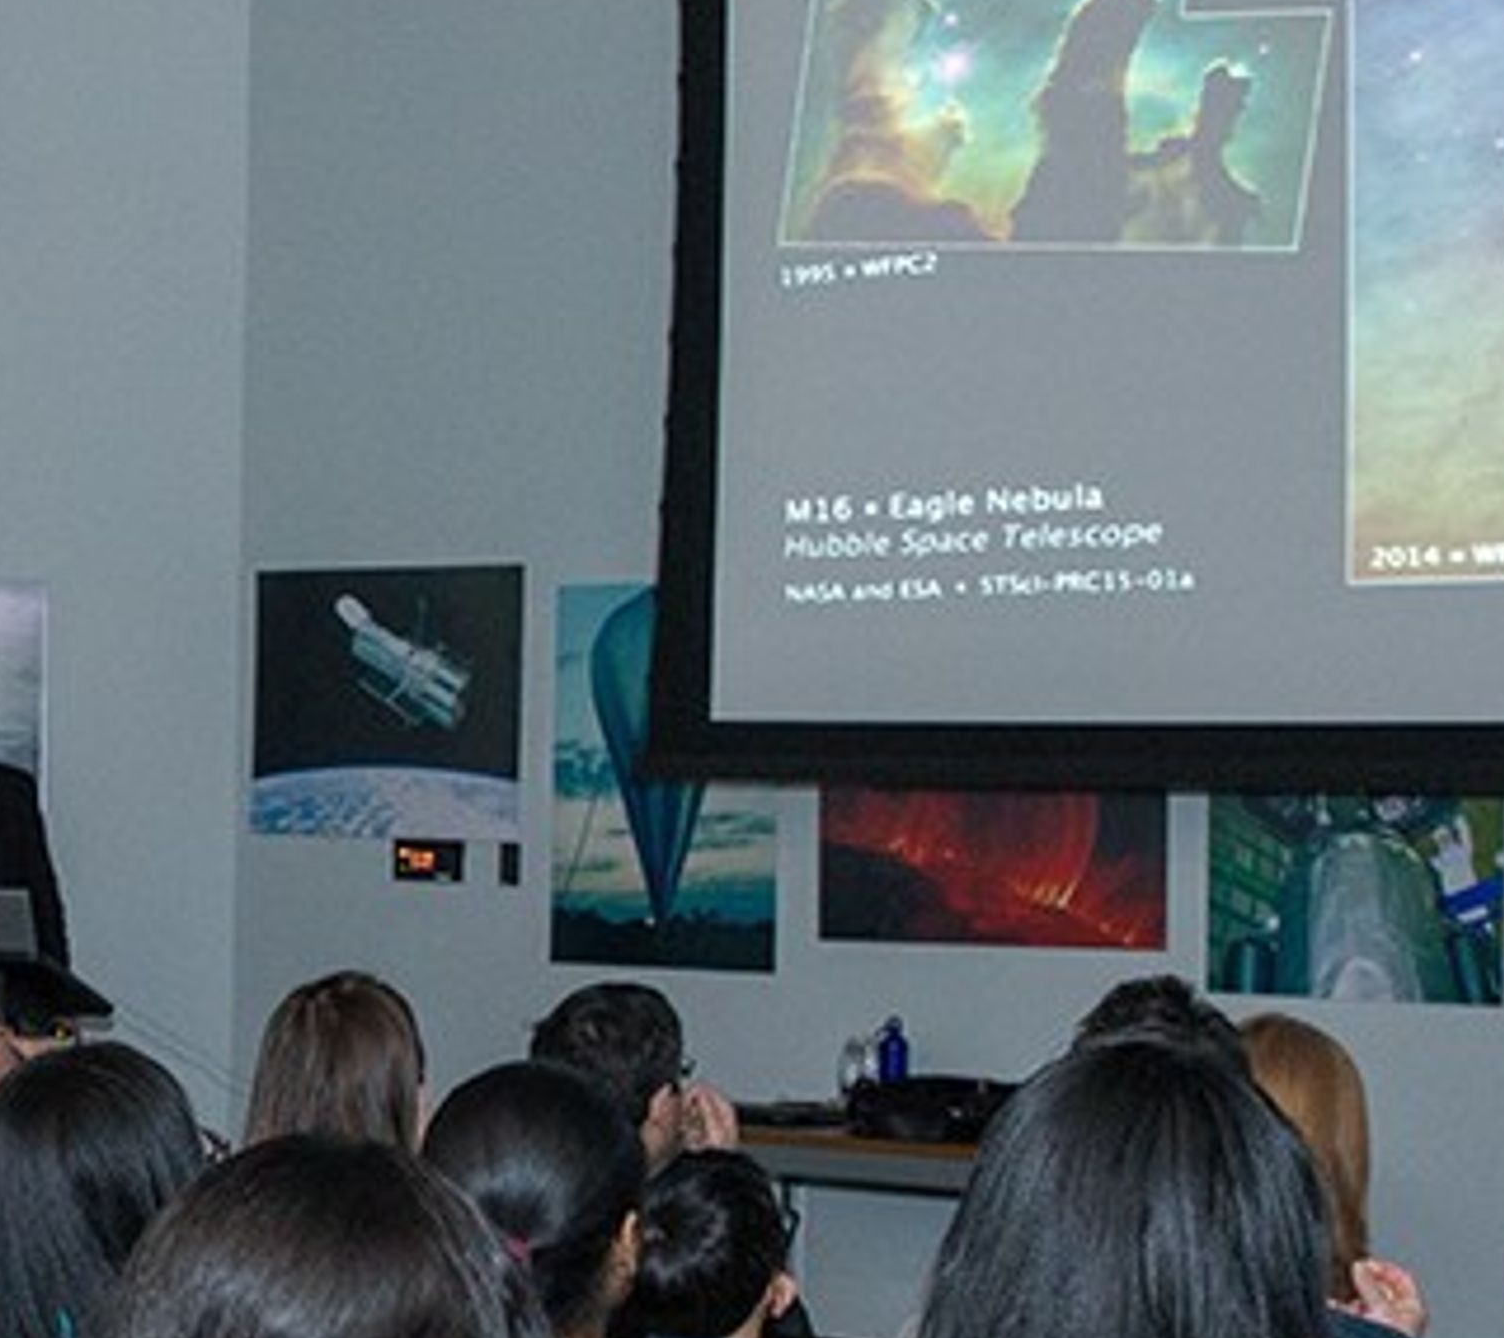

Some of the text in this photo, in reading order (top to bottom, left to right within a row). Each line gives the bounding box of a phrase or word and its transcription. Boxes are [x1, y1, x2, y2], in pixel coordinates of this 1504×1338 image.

[780, 251, 937, 287] 1995 WFPC2
[785, 482, 1104, 524] M16 Eagle Nebula
[784, 521, 1163, 559] Hubble Space Telescope
[1370, 545, 1441, 570] 2014
[785, 581, 845, 604] NASA
[851, 579, 893, 601] and
[899, 578, 943, 600] ESA
